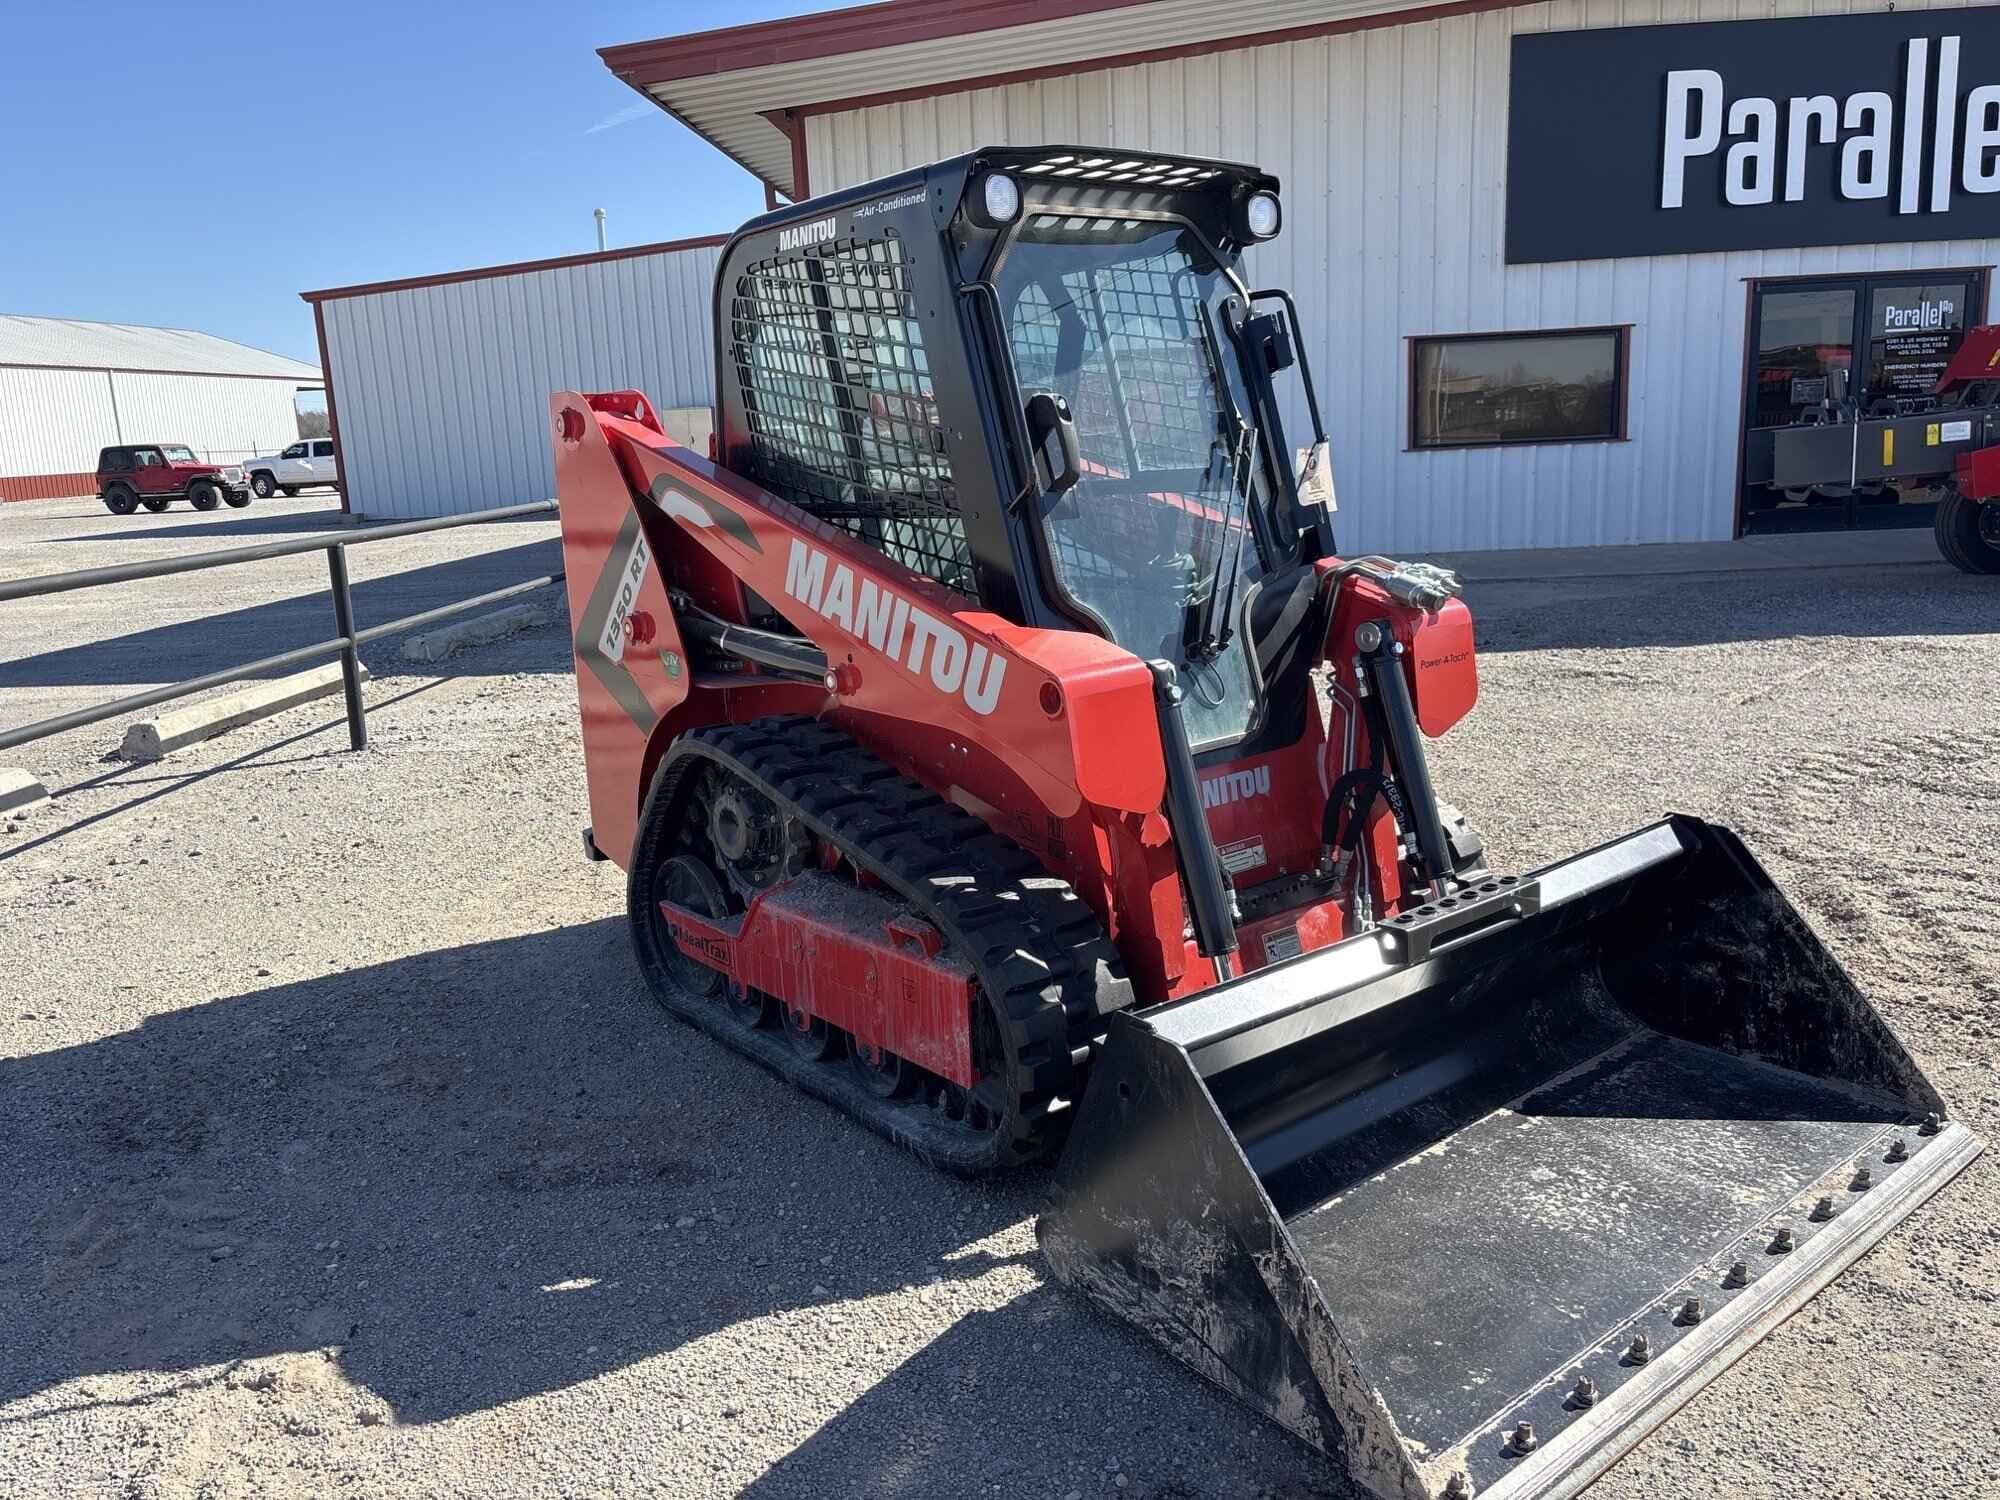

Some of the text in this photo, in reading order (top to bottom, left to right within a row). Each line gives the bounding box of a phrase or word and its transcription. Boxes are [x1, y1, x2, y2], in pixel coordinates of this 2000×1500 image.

[1661, 36, 2000, 213] Paralle
[864, 189, 927, 217] Air-Conditioned
[779, 216, 837, 252] MANITOU
[1885, 301, 1943, 328] Parallel
[606, 539, 646, 650] 1350 RT
[785, 538, 1008, 716] MANITOU
[1201, 765, 1270, 809] NITOU
